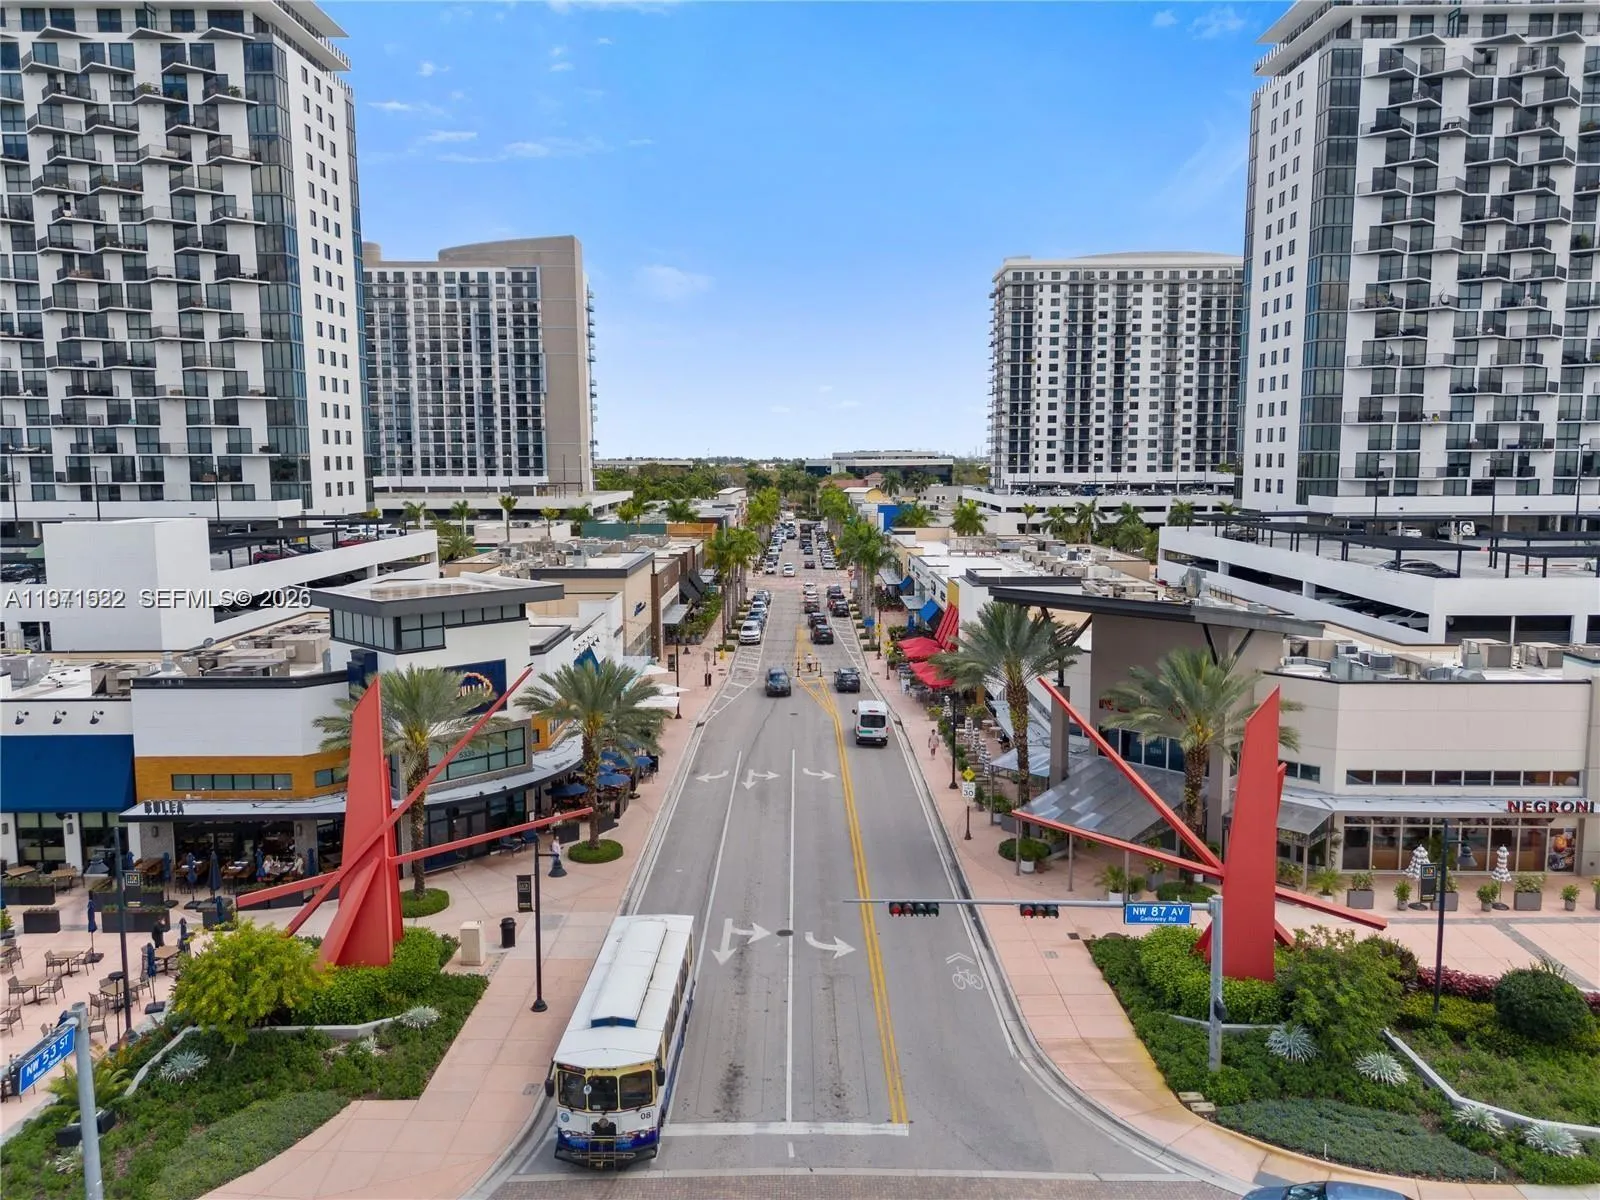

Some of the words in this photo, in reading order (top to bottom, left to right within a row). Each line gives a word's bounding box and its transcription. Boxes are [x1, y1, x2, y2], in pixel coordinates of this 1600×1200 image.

[1507, 800, 1595, 814] NEGRONI
[1132, 907, 1146, 915] NW
[1151, 906, 1166, 916] 87
[1171, 907, 1184, 915] AV
[26, 1058, 40, 1077] NW
[42, 1044, 57, 1065] 53
[59, 1034, 69, 1050] ST
[640, 1112, 651, 1120] 08
